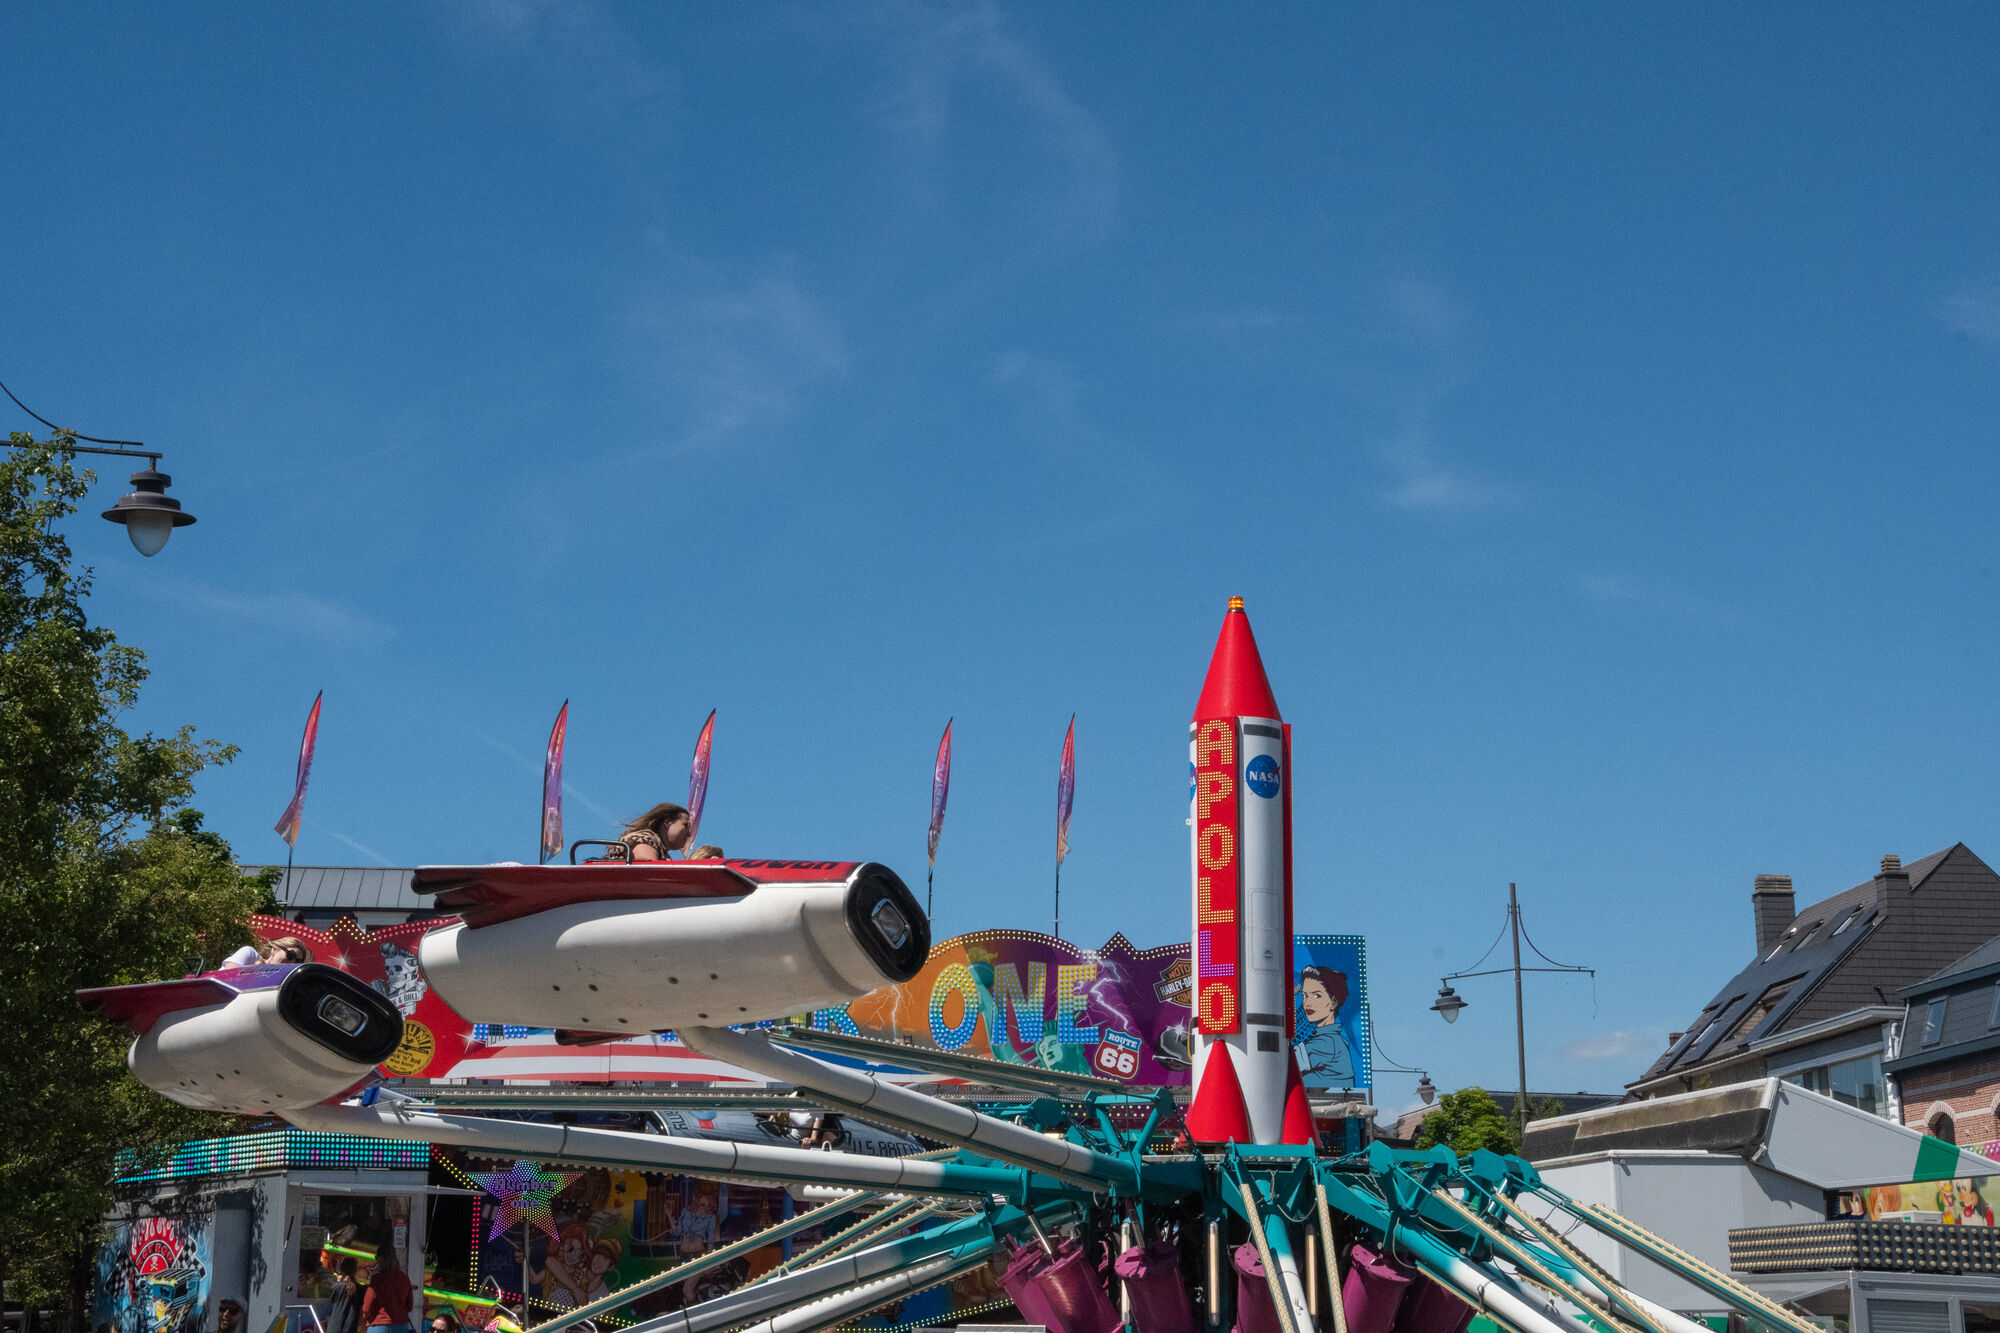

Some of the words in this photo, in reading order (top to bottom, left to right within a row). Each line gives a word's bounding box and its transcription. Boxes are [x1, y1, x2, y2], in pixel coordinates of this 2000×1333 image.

[1249, 770, 1280, 785] NASA
[1198, 719, 1235, 1031] APOLLO
[928, 961, 1100, 1051] ONE
[1108, 1033, 1138, 1048] ROUTE
[1100, 1047, 1135, 1074] 66
[495, 1179, 557, 1191] Number
[510, 1199, 539, 1209] one
